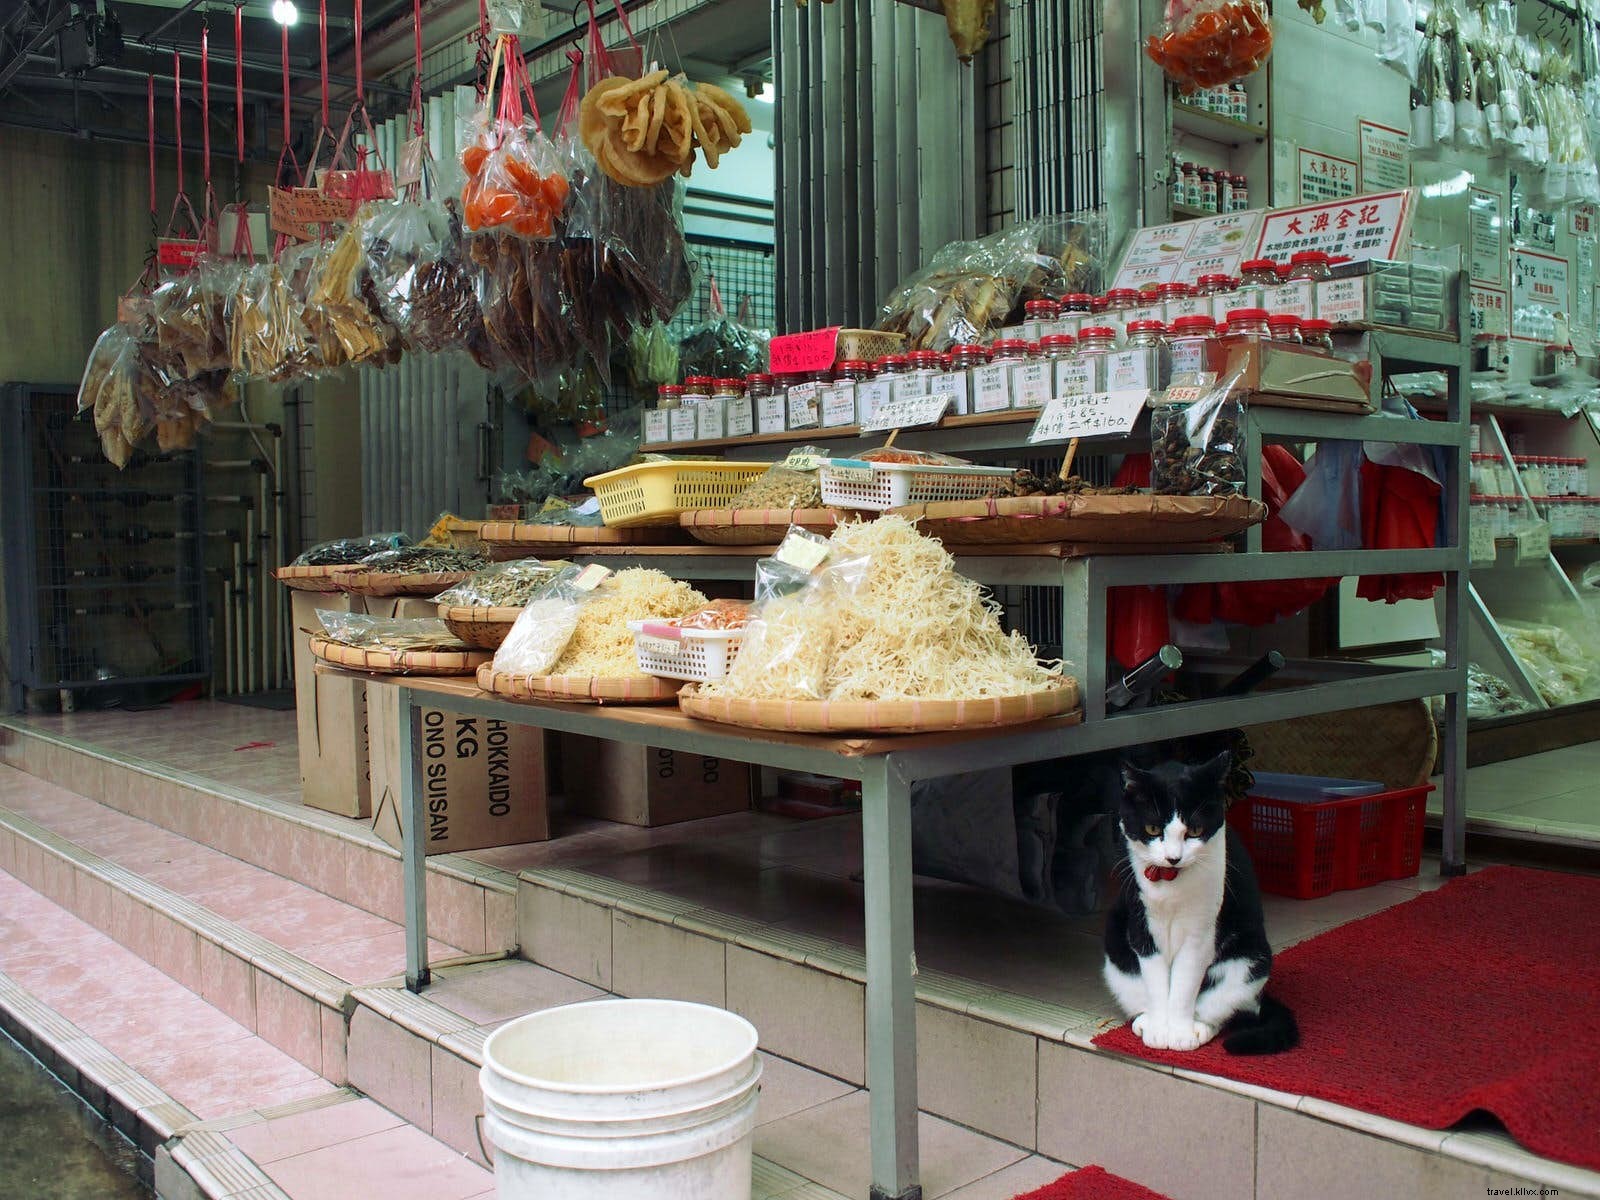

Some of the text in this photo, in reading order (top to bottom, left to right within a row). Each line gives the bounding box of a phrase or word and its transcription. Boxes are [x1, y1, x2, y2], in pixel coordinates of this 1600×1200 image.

[1285, 204, 1381, 237] 大澳全記
[456, 718, 479, 758] KG
[486, 719, 511, 817] HOKKAIDO
[425, 711, 449, 841] ONO SUISAN
